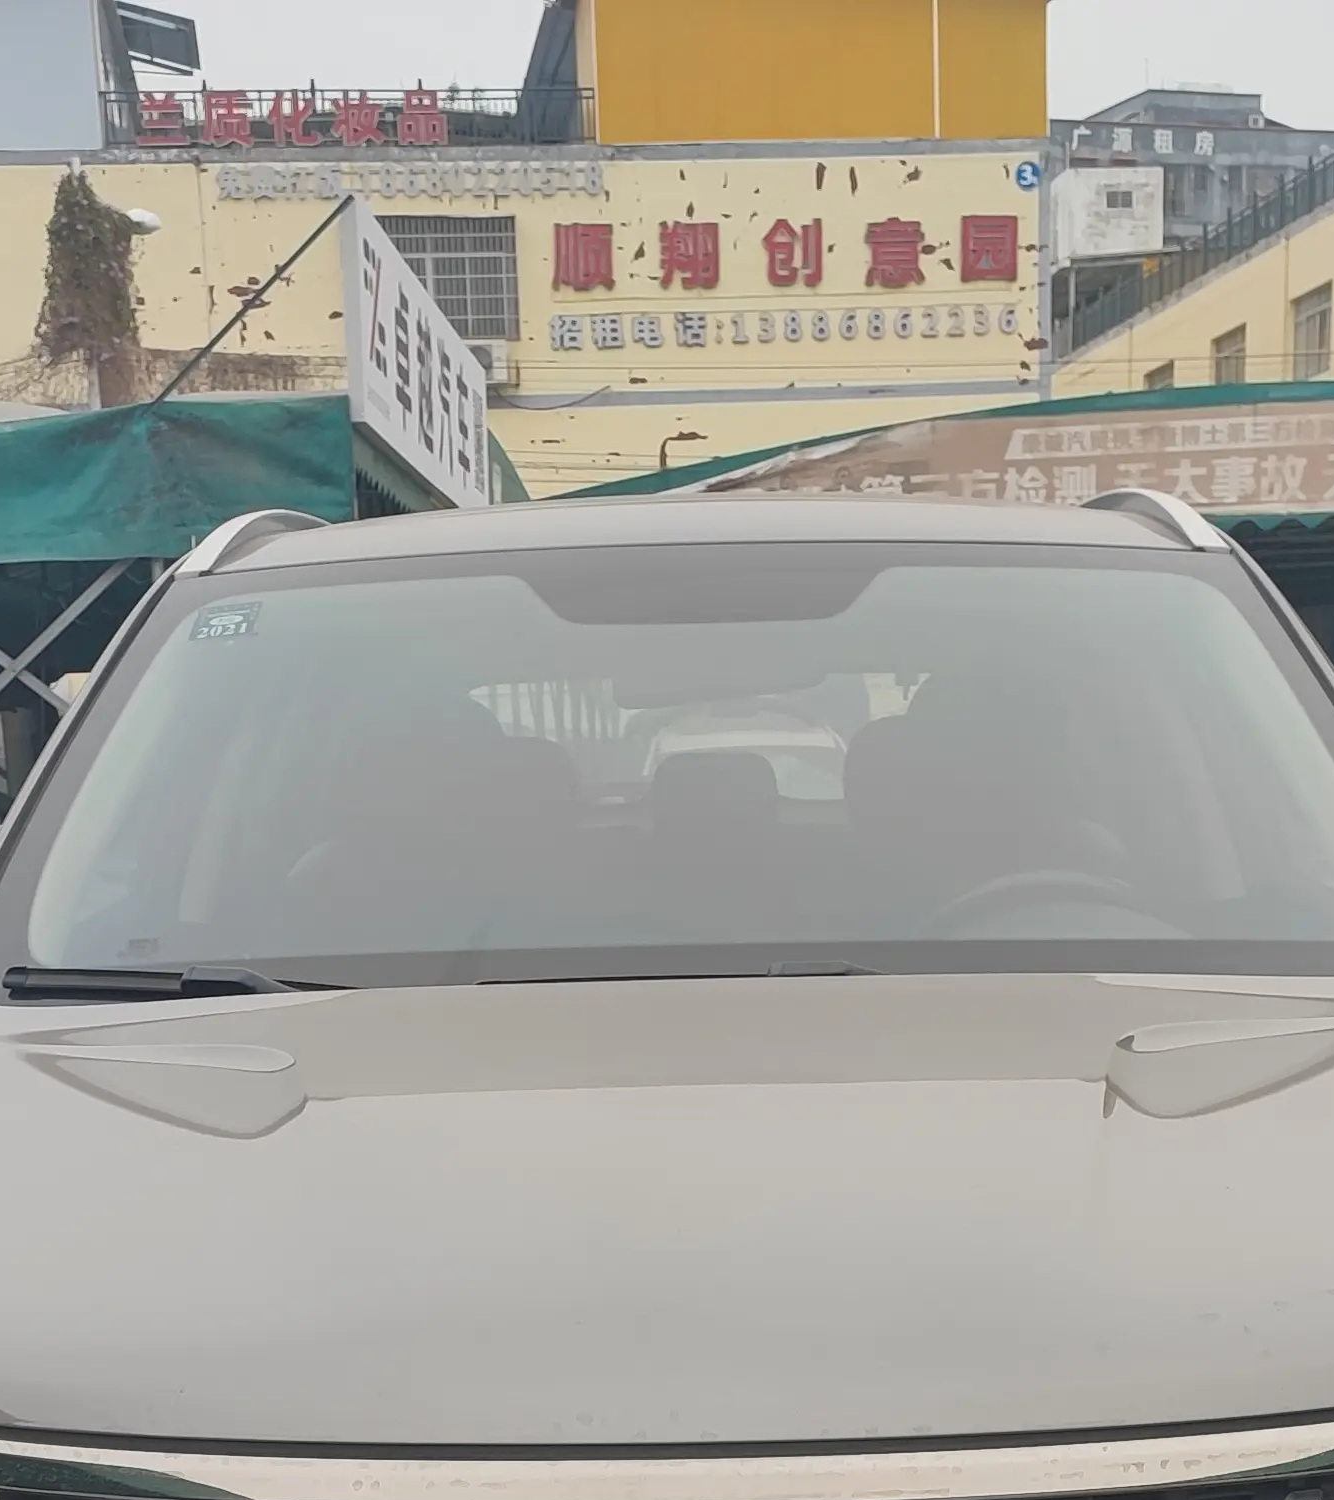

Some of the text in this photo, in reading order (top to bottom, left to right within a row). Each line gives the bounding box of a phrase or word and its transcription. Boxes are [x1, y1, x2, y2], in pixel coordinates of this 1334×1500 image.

[138, 90, 449, 147] 兰质化妆品
[552, 215, 1018, 291] 顺翔创意园
[394, 280, 471, 491] 卓越汽车
[196, 622, 247, 639] 2021
